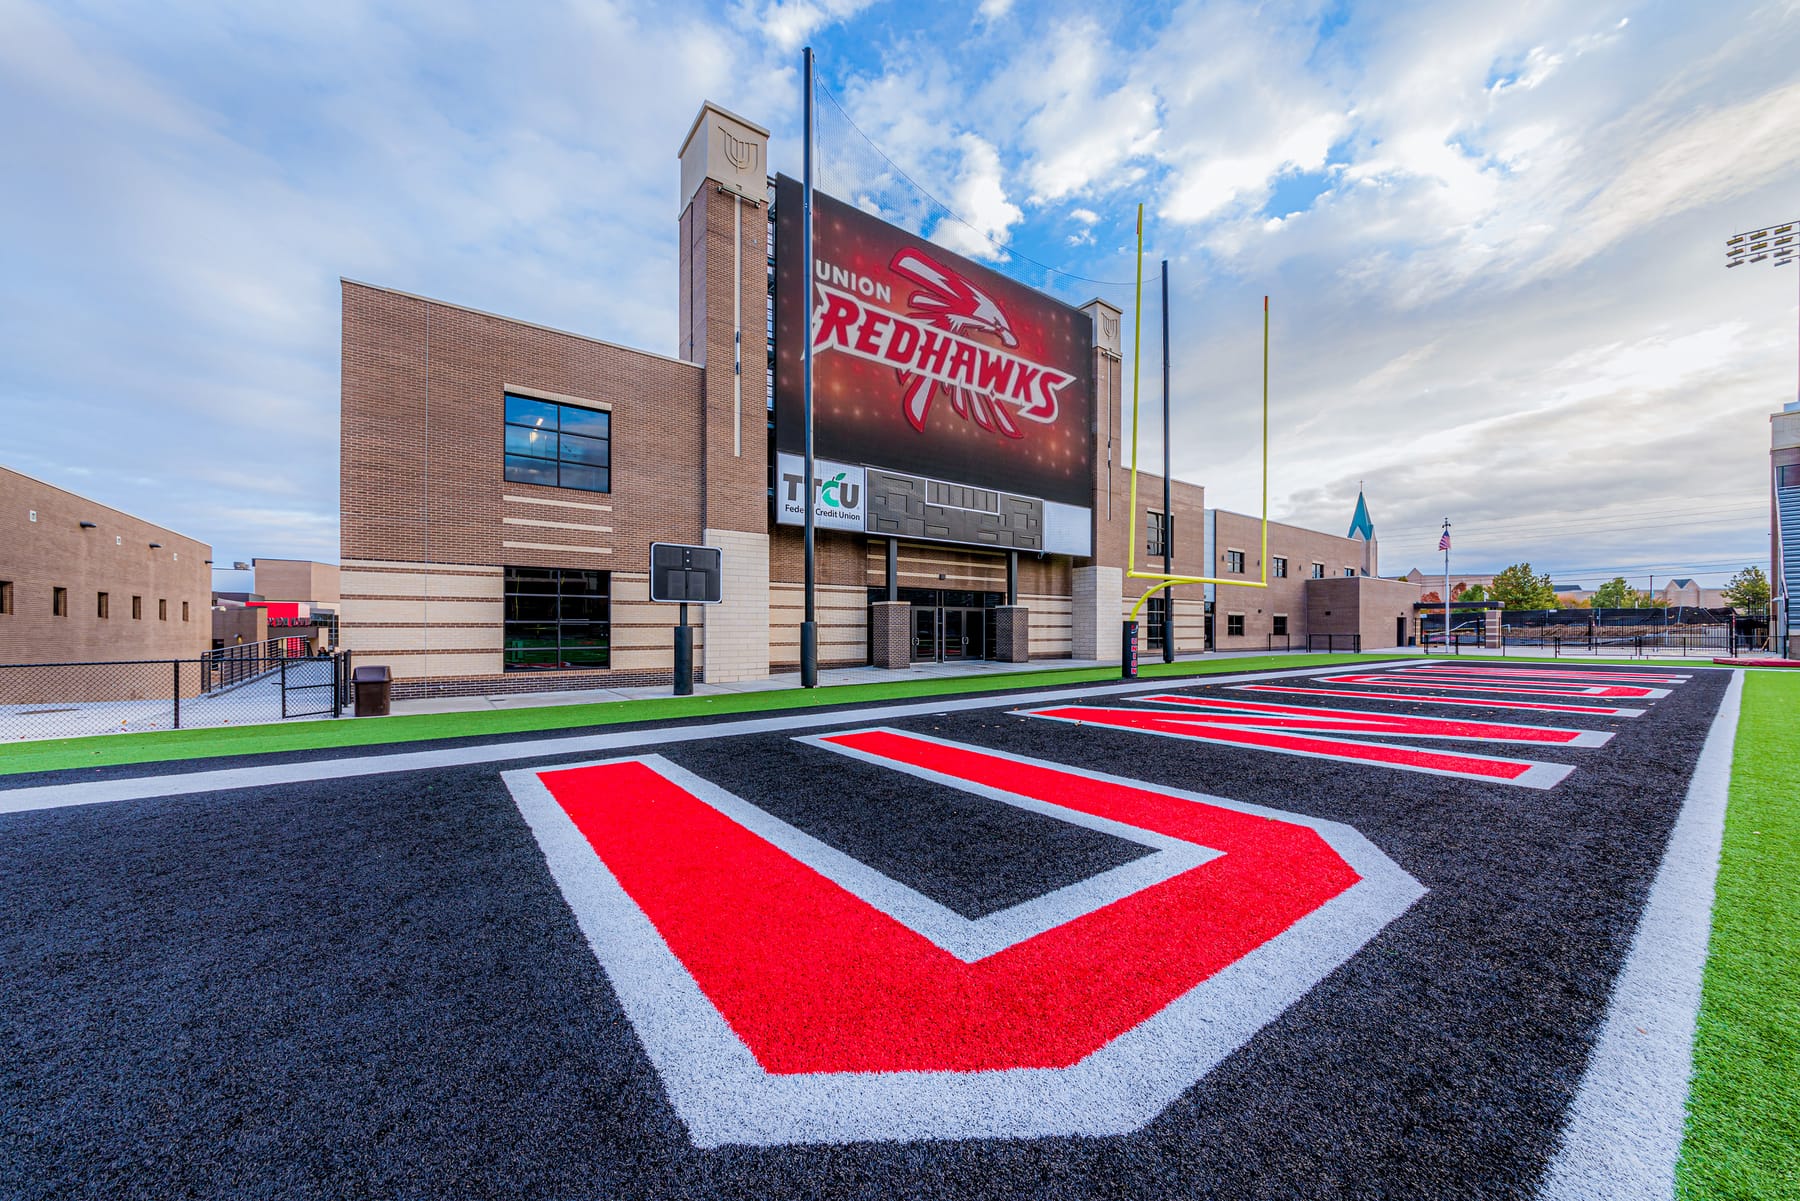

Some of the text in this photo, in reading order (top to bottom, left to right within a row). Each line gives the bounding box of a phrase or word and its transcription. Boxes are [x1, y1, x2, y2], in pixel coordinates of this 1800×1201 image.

[815, 258, 892, 304] UNION
[808, 284, 1076, 424] REDHAWKS
[784, 504, 861, 520] Fede Credit Union
